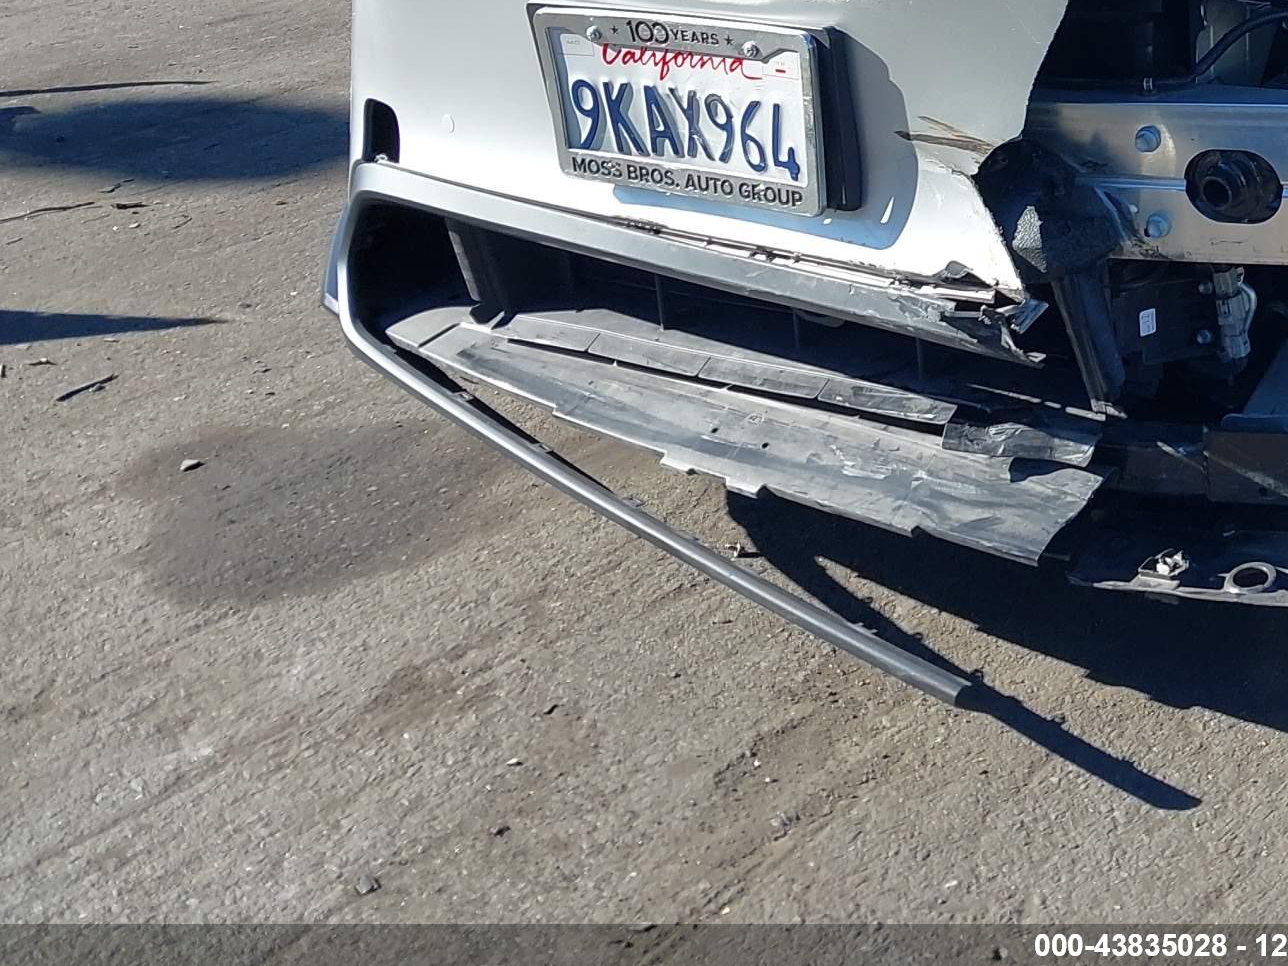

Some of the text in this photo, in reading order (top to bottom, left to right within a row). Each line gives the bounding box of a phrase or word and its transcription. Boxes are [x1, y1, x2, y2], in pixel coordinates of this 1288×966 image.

[626, 20, 720, 46] 100 YEARS
[602, 43, 762, 81] California
[571, 79, 801, 182] 9KAX964
[572, 156, 804, 207] MOSS BROS. AUTO GROUP
